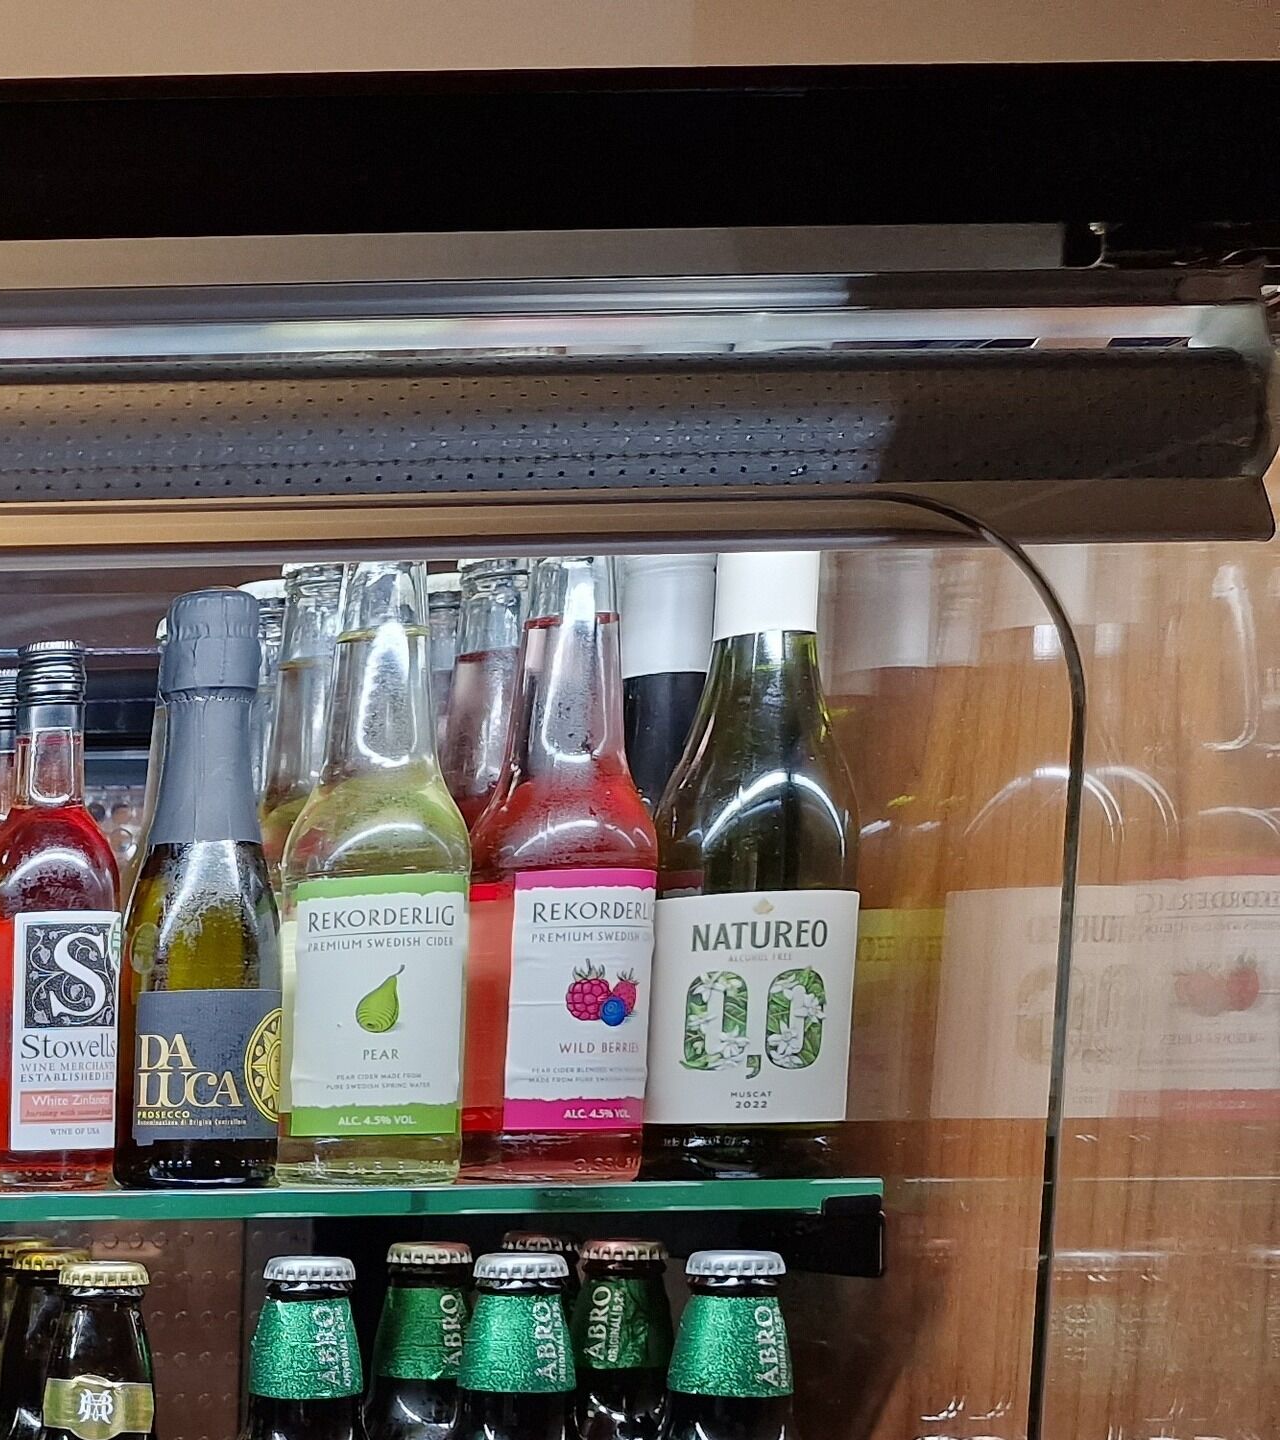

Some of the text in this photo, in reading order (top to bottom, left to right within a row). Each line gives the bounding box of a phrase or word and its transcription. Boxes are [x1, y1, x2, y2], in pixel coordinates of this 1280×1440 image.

[308, 905, 455, 933] REKORDERLIG
[532, 932, 593, 944] PREMIUM
[692, 920, 827, 952] NATUREO
[308, 935, 454, 952] PREMIUM SWEDISH CIDER
[49, 930, 106, 1019] S
[20, 1033, 115, 1059] Stowells
[138, 1033, 196, 1070] DA
[559, 1042, 595, 1054] WILD
[363, 1048, 399, 1061] PEAR
[20, 1063, 55, 1072] WINE
[137, 1069, 243, 1108] LUCA
[32, 1095, 69, 1106] White
[731, 1091, 772, 1099] MUSCAT
[735, 1101, 768, 1109] 2022
[137, 1110, 190, 1119] PROSECCO
[363, 1116, 391, 1125] 4.5%
